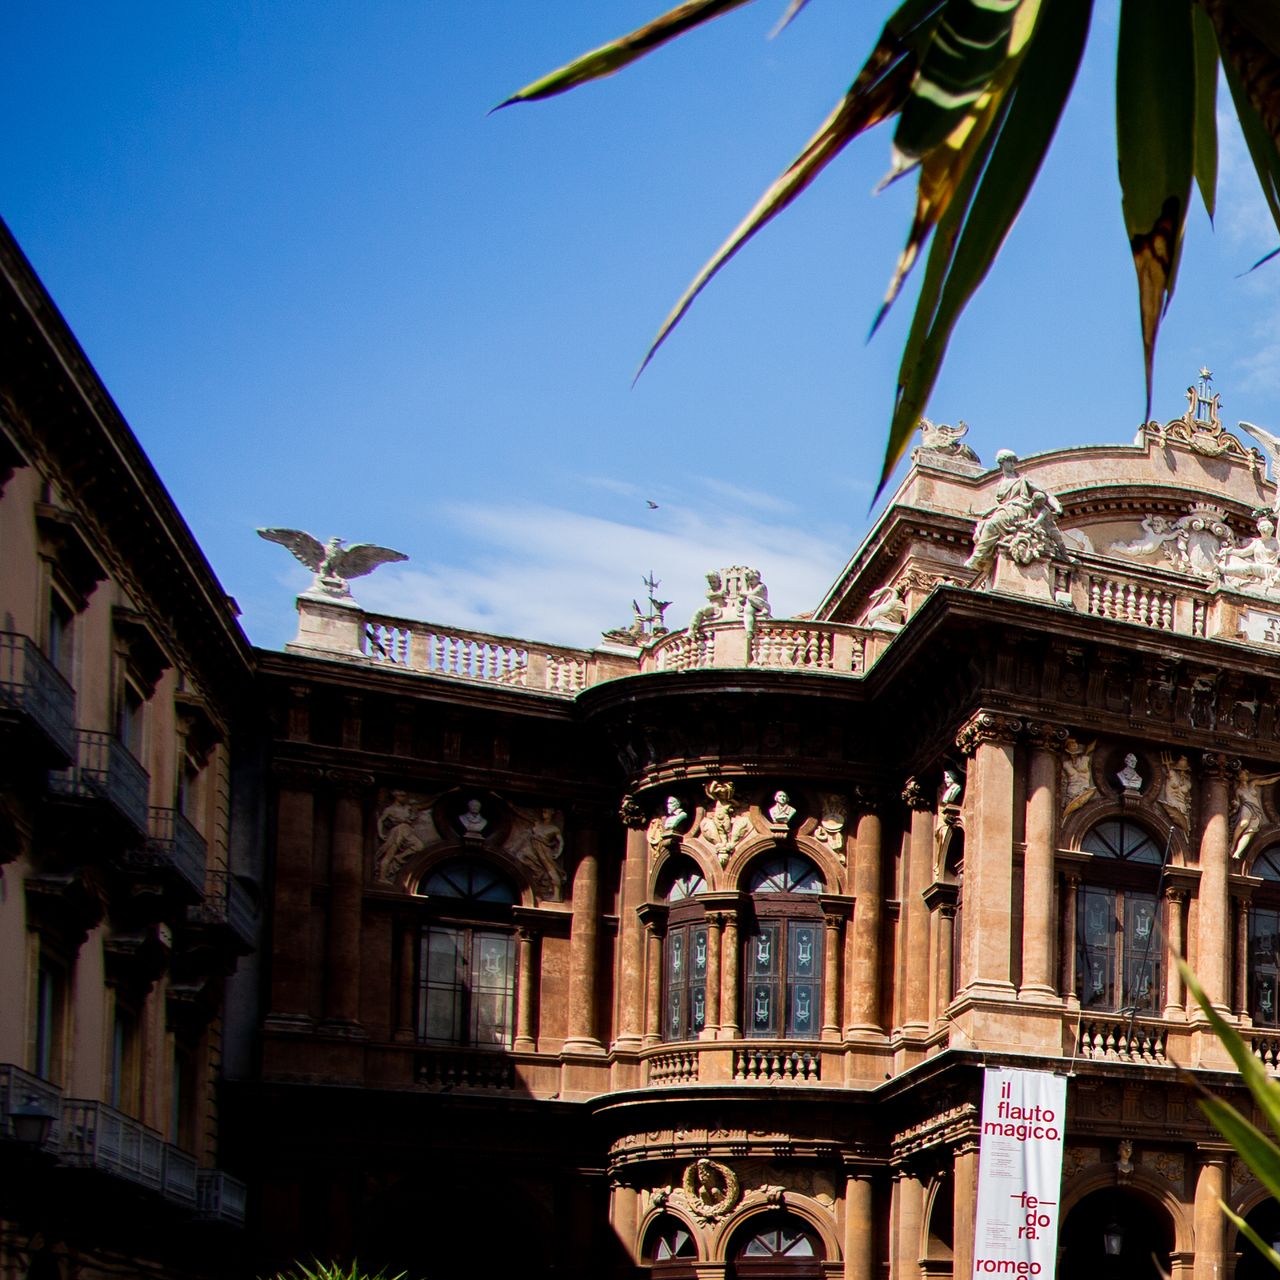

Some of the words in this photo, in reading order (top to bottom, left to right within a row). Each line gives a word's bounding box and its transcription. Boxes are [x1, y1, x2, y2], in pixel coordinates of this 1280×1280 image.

[1001, 1081, 1011, 1099] il
[997, 1101, 1055, 1122] flauto
[984, 1121, 1061, 1141] magico.
[1025, 1210, 1050, 1227] do
[1018, 1226, 1040, 1240] ra.
[976, 1259, 1042, 1275] romeo
